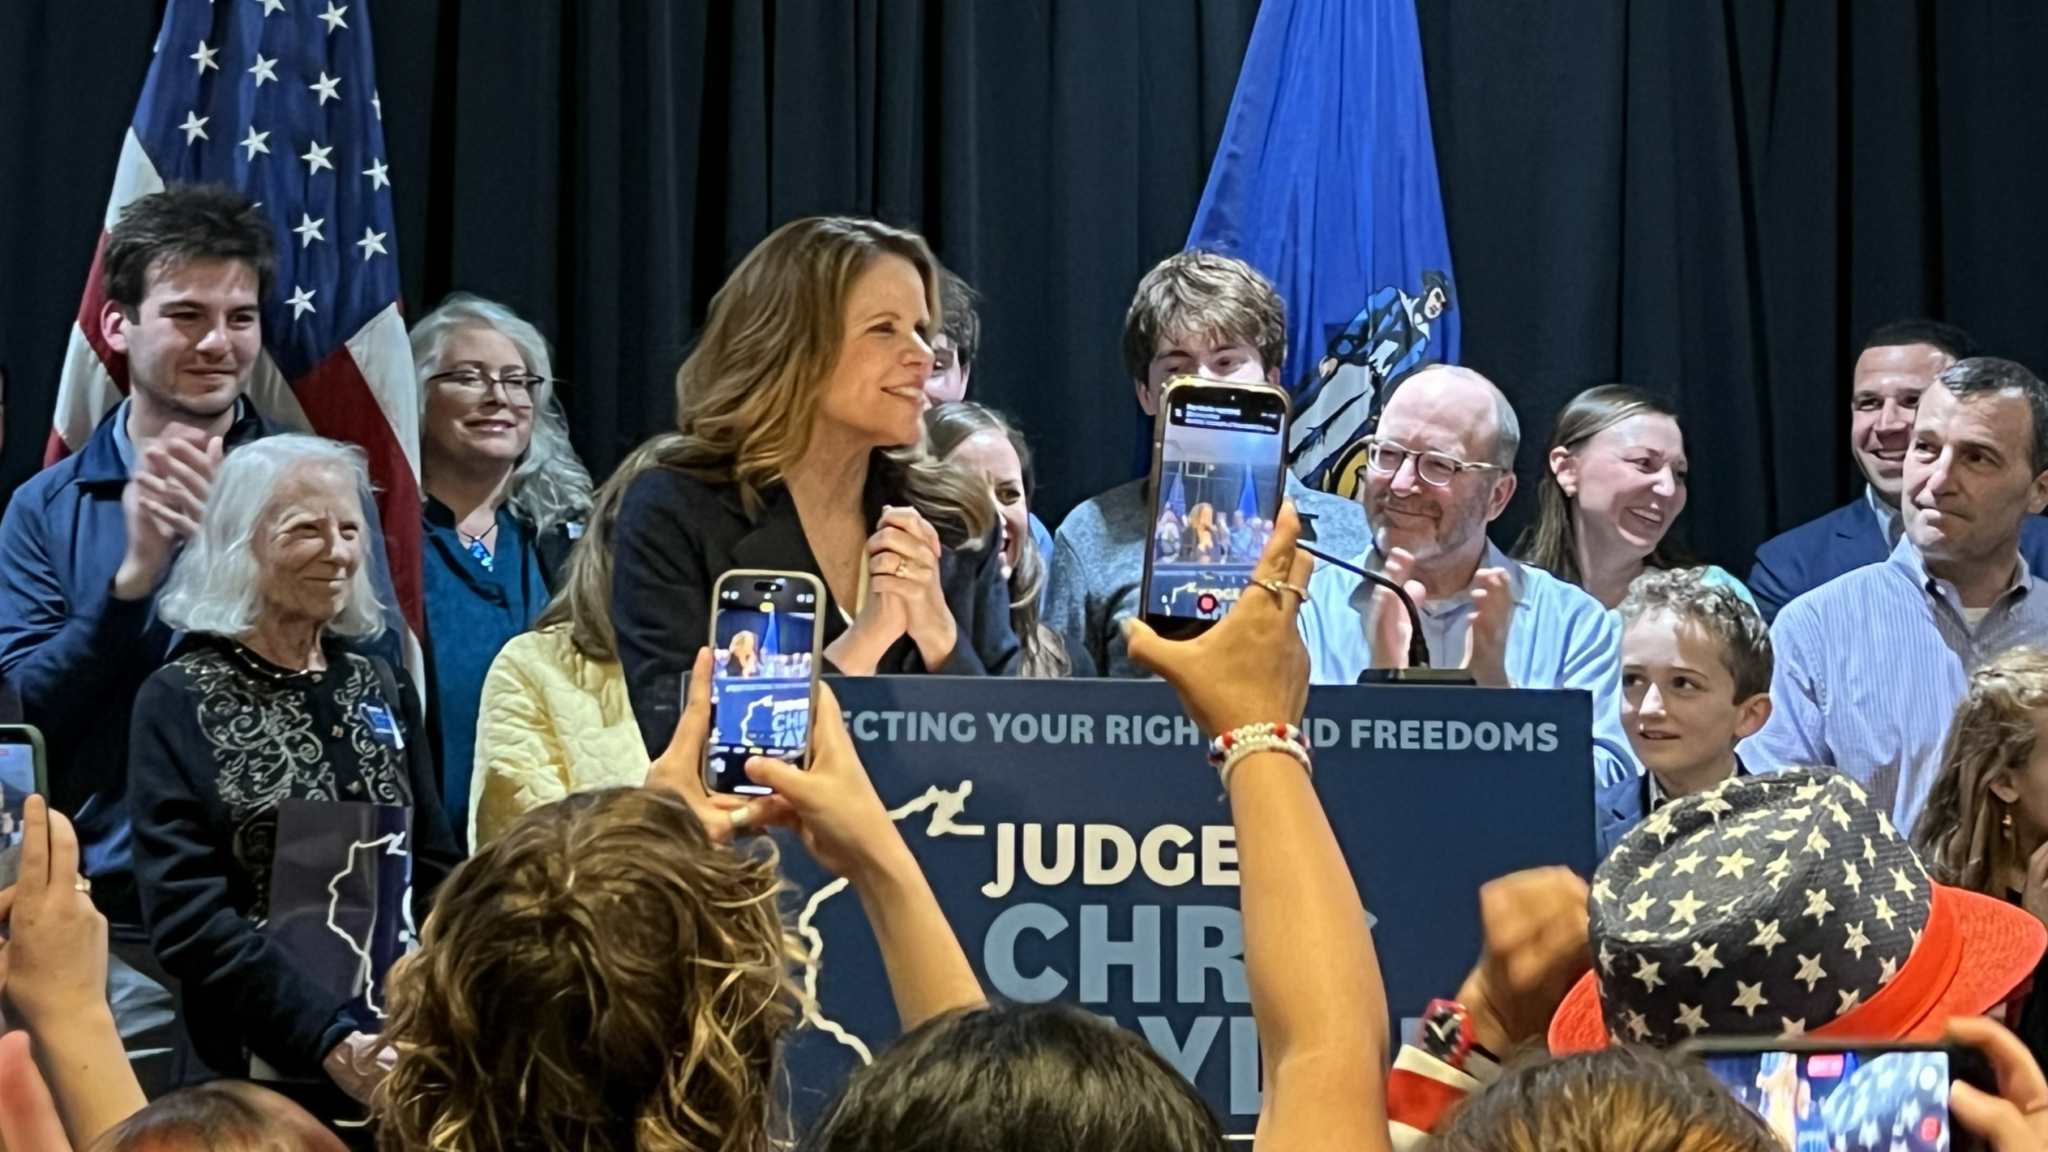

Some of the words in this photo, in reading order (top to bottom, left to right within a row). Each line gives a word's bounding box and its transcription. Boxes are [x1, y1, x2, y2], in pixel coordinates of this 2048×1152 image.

[842, 711, 977, 742] CTING
[986, 712, 1094, 744] YOUR
[1106, 714, 1200, 746] RIGH
[1351, 719, 1559, 752] FREEDOMS
[981, 823, 1241, 898] JUDGE
[983, 902, 1378, 1003] CHR
